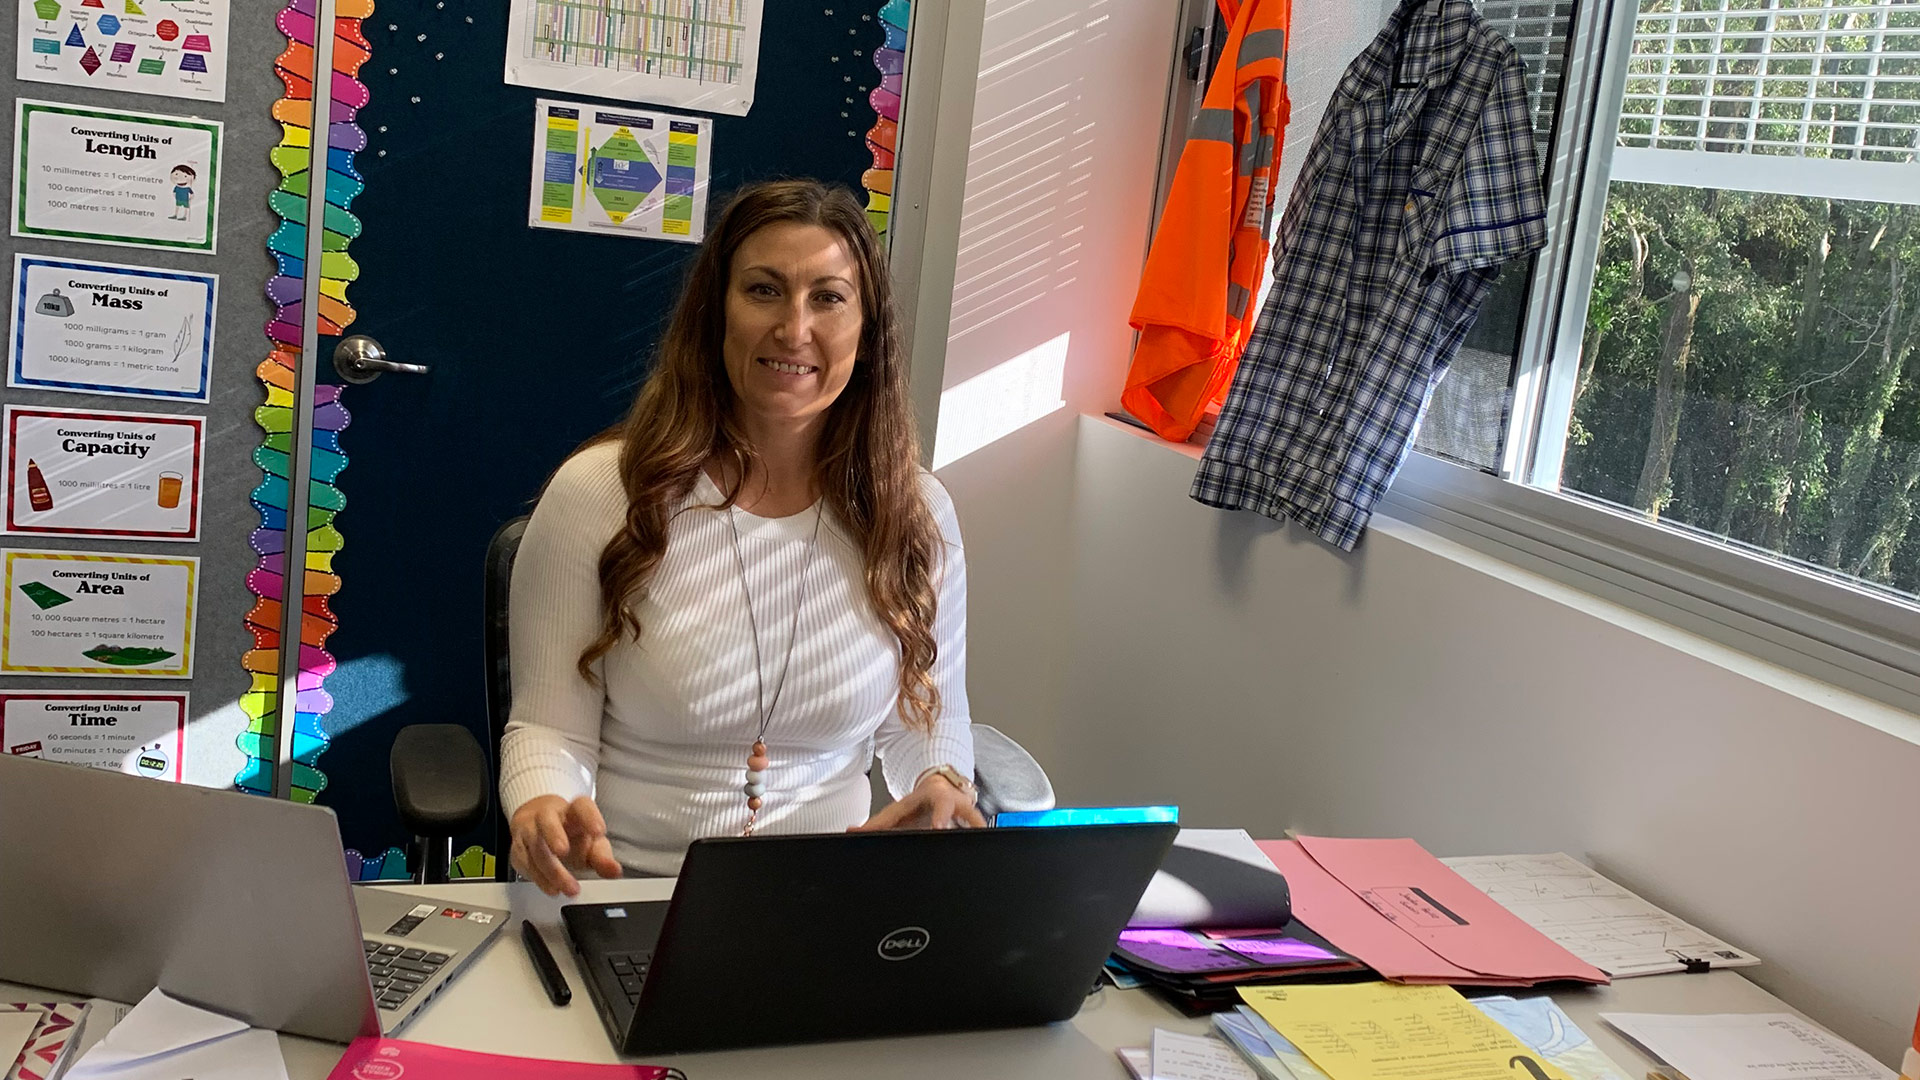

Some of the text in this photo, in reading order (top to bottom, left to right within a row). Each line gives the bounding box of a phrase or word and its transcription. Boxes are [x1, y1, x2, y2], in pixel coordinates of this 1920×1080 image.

[71, 126, 173, 145] Converting Units of
[85, 138, 156, 161] Length
[53, 167, 101, 178] millimetres
[118, 174, 163, 184] centimetre
[64, 185, 115, 196] centimetres
[48, 200, 67, 208] 1000
[70, 203, 99, 212] metres
[116, 207, 155, 217] kilometre
[68, 280, 126, 295] Converting
[128, 286, 155, 296] Units
[92, 292, 143, 310] Mass
[64, 322, 84, 331] 1000
[85, 326, 129, 336] milligrams
[64, 340, 84, 348] 1000
[128, 346, 164, 355] kilogram
[49, 355, 68, 363] 1000
[70, 357, 111, 367] kilograms
[127, 362, 154, 371] metric
[57, 428, 114, 440] Converting
[117, 432, 143, 440] Units
[62, 439, 150, 459] Capacity
[52, 570, 109, 581] Converting
[111, 572, 137, 581] Units
[76, 581, 124, 595] Area
[127, 632, 164, 640] kilometre
[45, 704, 101, 713] Converting
[68, 713, 118, 726] Time
[15, 744, 37, 753] FRIDAY
[884, 938, 922, 950] DELL
